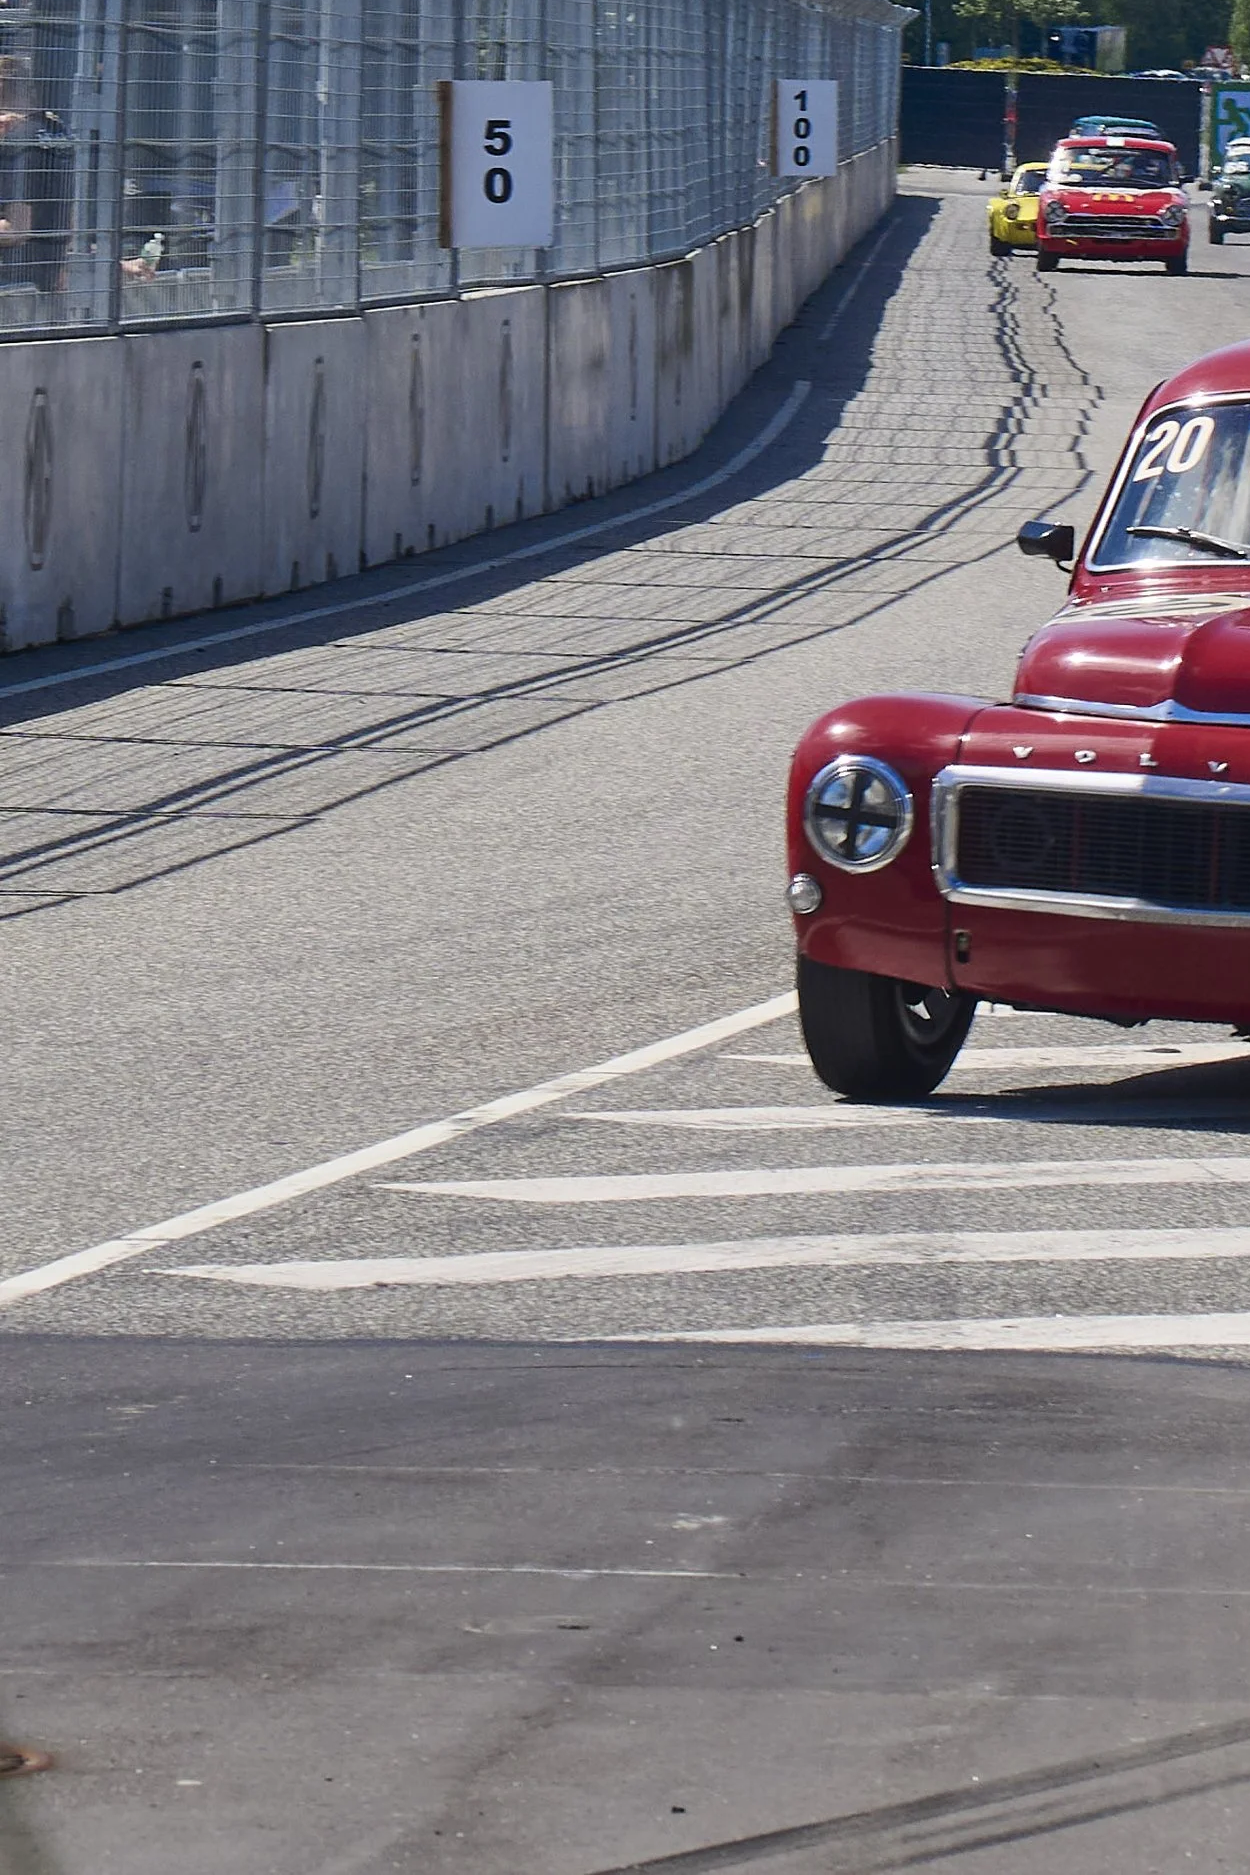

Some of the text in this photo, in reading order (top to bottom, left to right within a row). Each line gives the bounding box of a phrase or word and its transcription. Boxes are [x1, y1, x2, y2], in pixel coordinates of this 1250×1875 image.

[484, 119, 513, 204] 50
[793, 90, 811, 166] 100
[1132, 416, 1216, 482] 20
